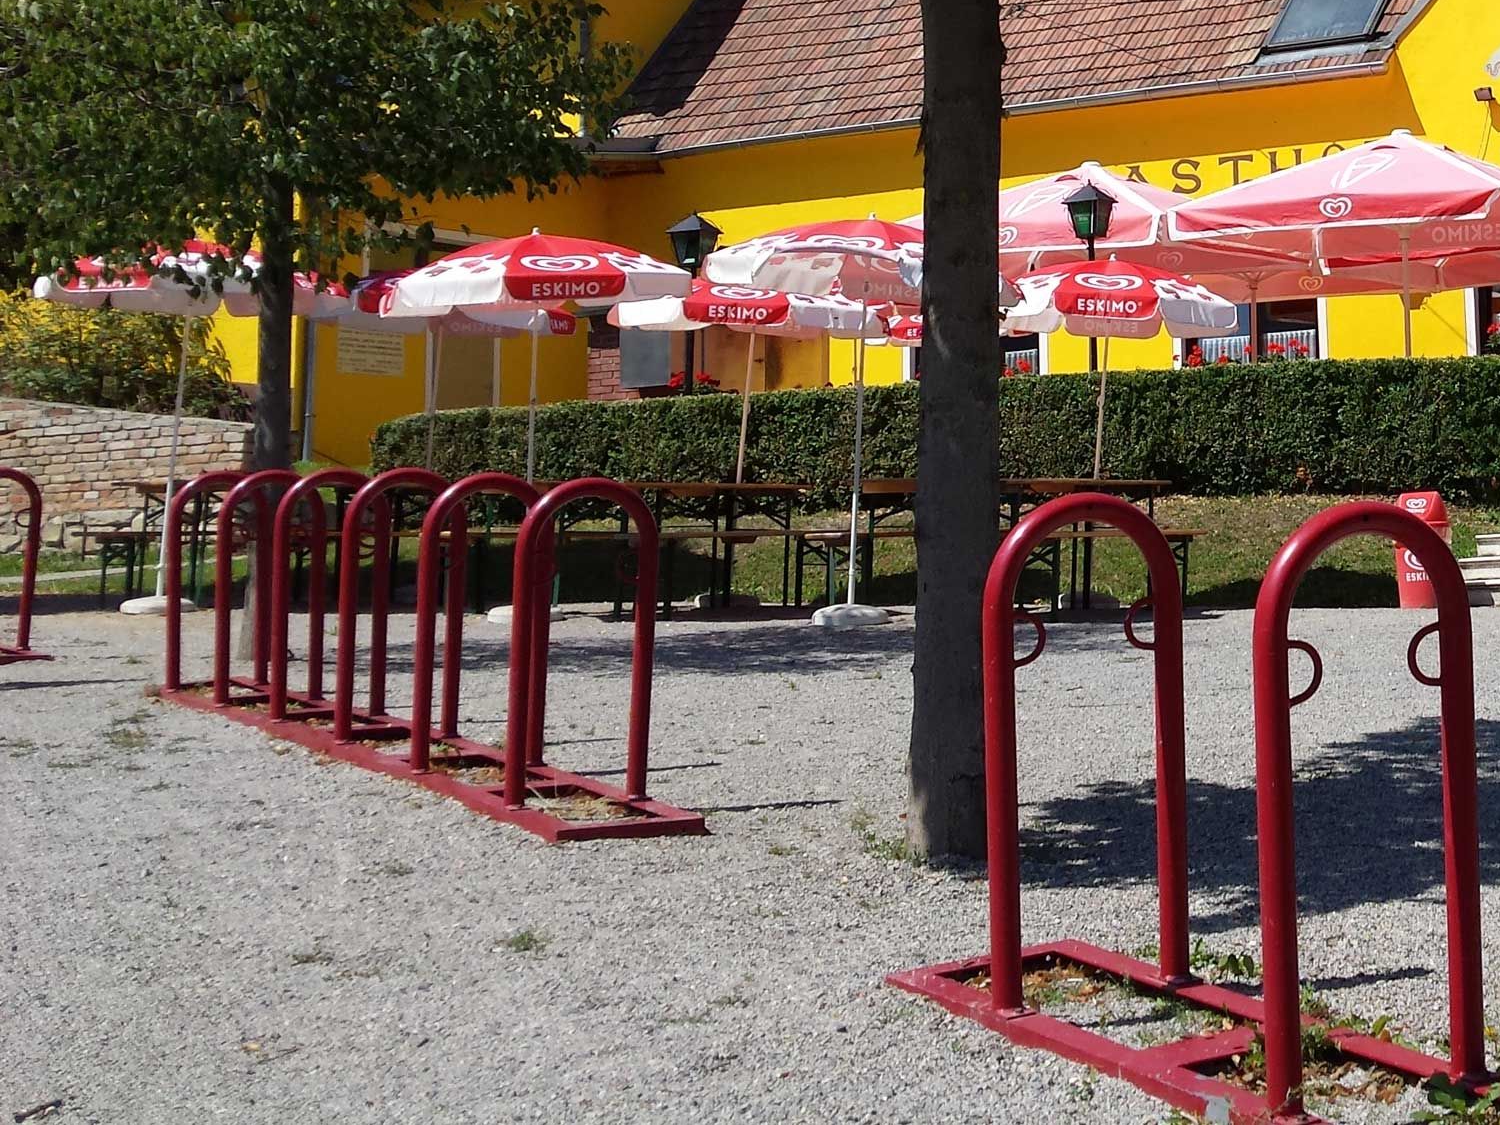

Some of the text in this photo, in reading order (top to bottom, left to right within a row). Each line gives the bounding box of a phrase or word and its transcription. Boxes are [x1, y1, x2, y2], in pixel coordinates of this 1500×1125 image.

[531, 281, 600, 298] ESKIMO
[708, 304, 767, 321] ESKIMO
[1077, 298, 1138, 313] ESKIMO
[1405, 572, 1430, 582] ESKI
